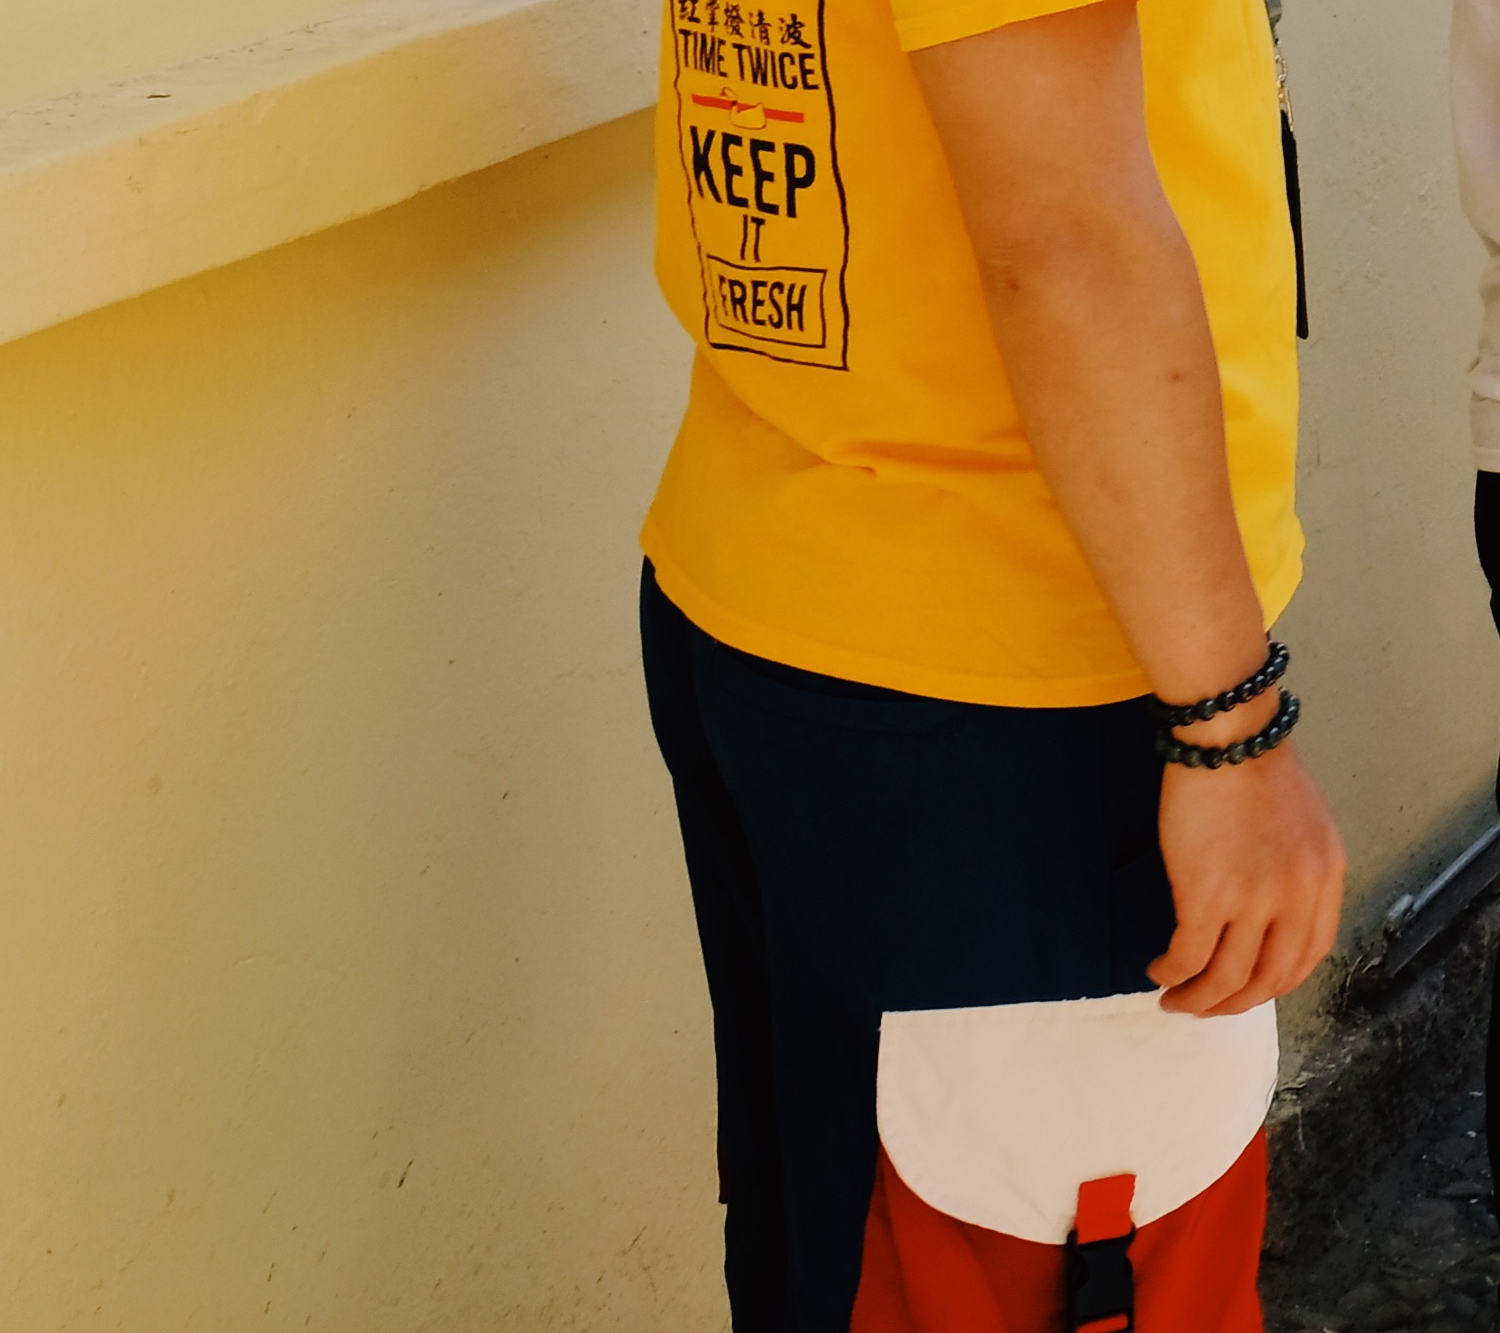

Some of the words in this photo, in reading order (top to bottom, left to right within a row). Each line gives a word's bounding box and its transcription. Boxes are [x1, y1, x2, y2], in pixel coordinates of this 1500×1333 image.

[678, 28, 729, 78] TIME
[732, 42, 820, 91] TWICE
[689, 125, 816, 218] KEEP
[739, 214, 766, 263] IT
[717, 274, 808, 332] FRESH
